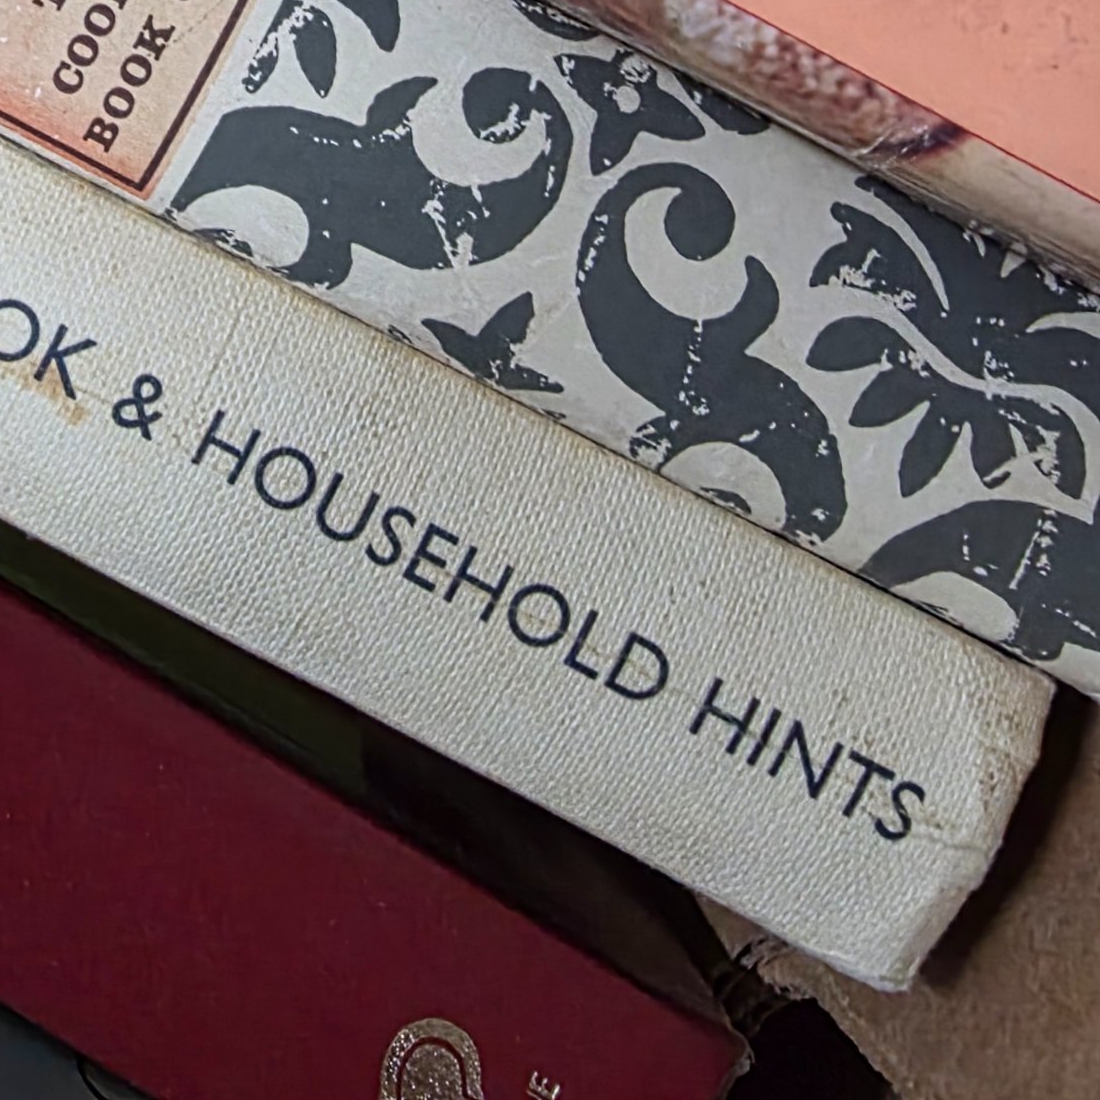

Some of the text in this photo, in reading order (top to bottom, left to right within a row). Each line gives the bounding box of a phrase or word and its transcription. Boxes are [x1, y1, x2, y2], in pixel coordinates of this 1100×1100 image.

[83, 14, 176, 153] BOOK
[110, 374, 164, 441] &
[190, 410, 669, 701] HOUSEHOLD
[688, 678, 926, 841] HINTS
